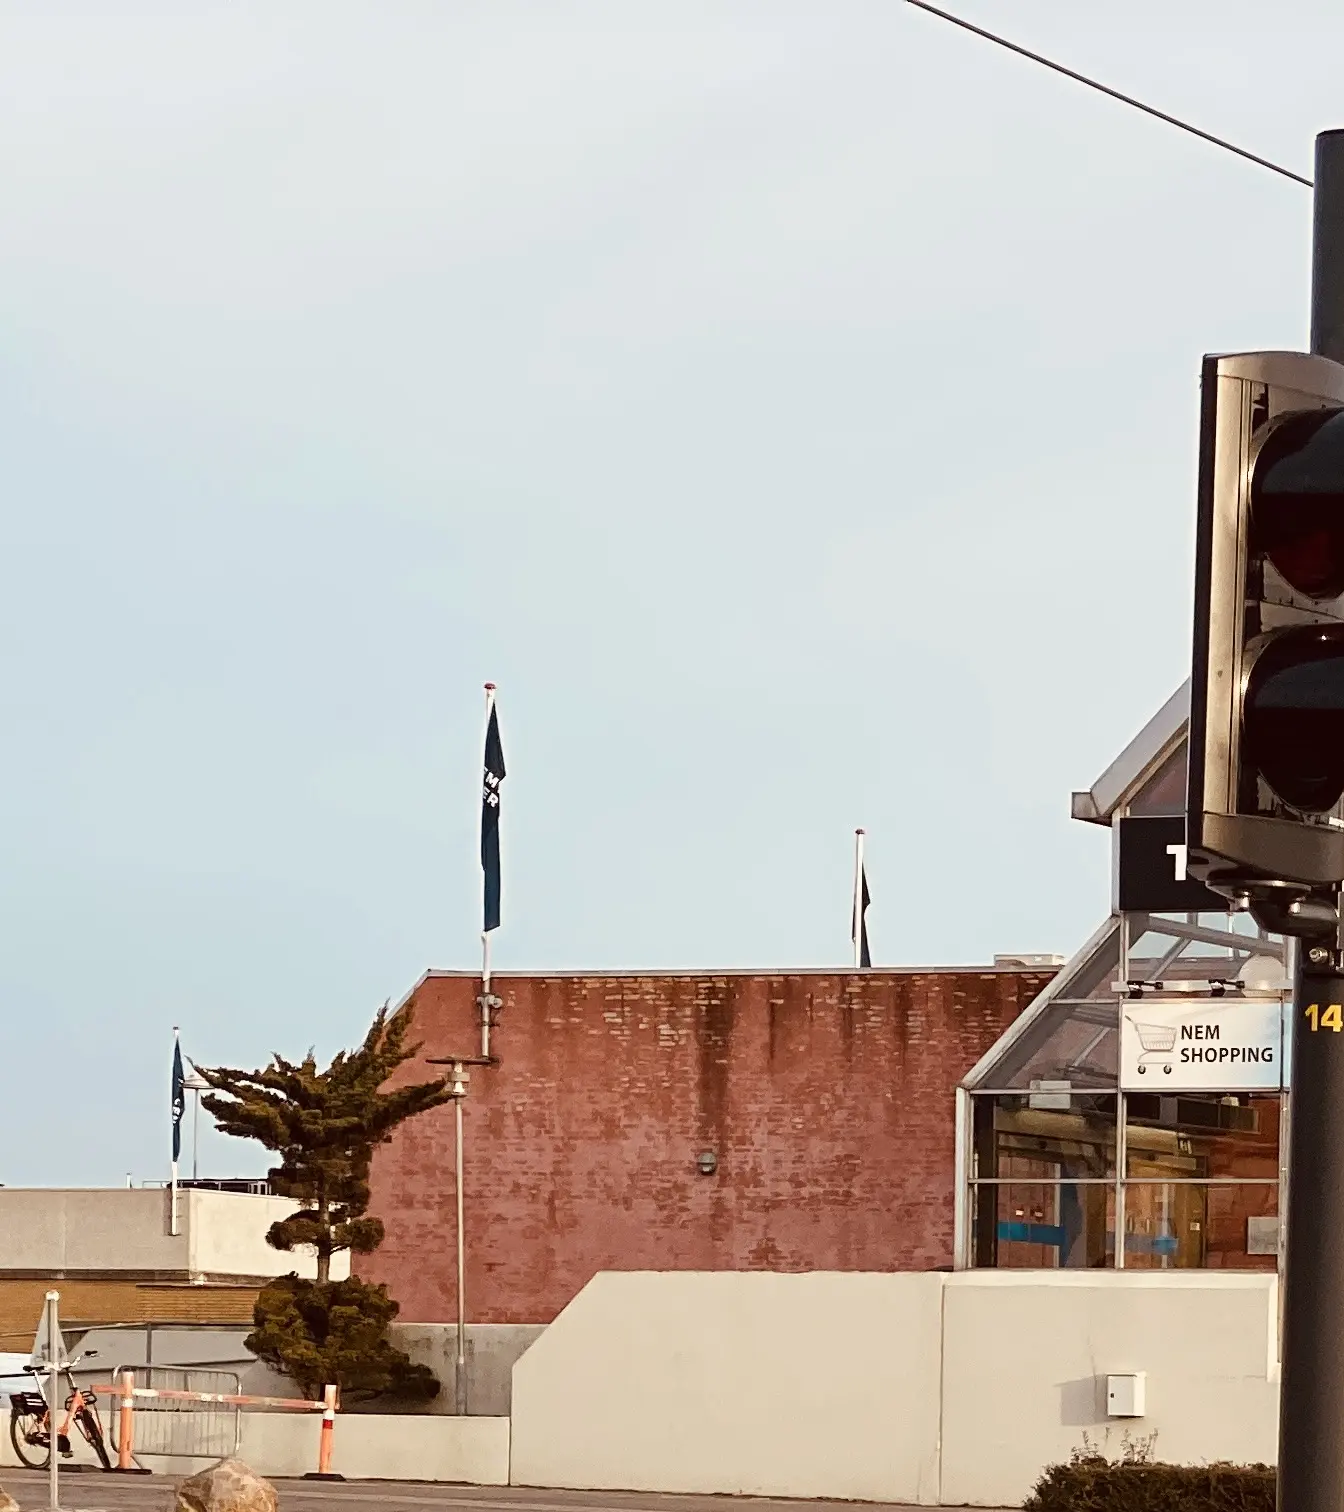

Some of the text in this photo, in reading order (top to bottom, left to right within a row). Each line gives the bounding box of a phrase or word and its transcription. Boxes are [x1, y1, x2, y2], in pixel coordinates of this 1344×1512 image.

[1305, 1004, 1343, 1032] 14
[1181, 1025, 1220, 1040] NEM
[1180, 1047, 1273, 1063] SHOPPING
